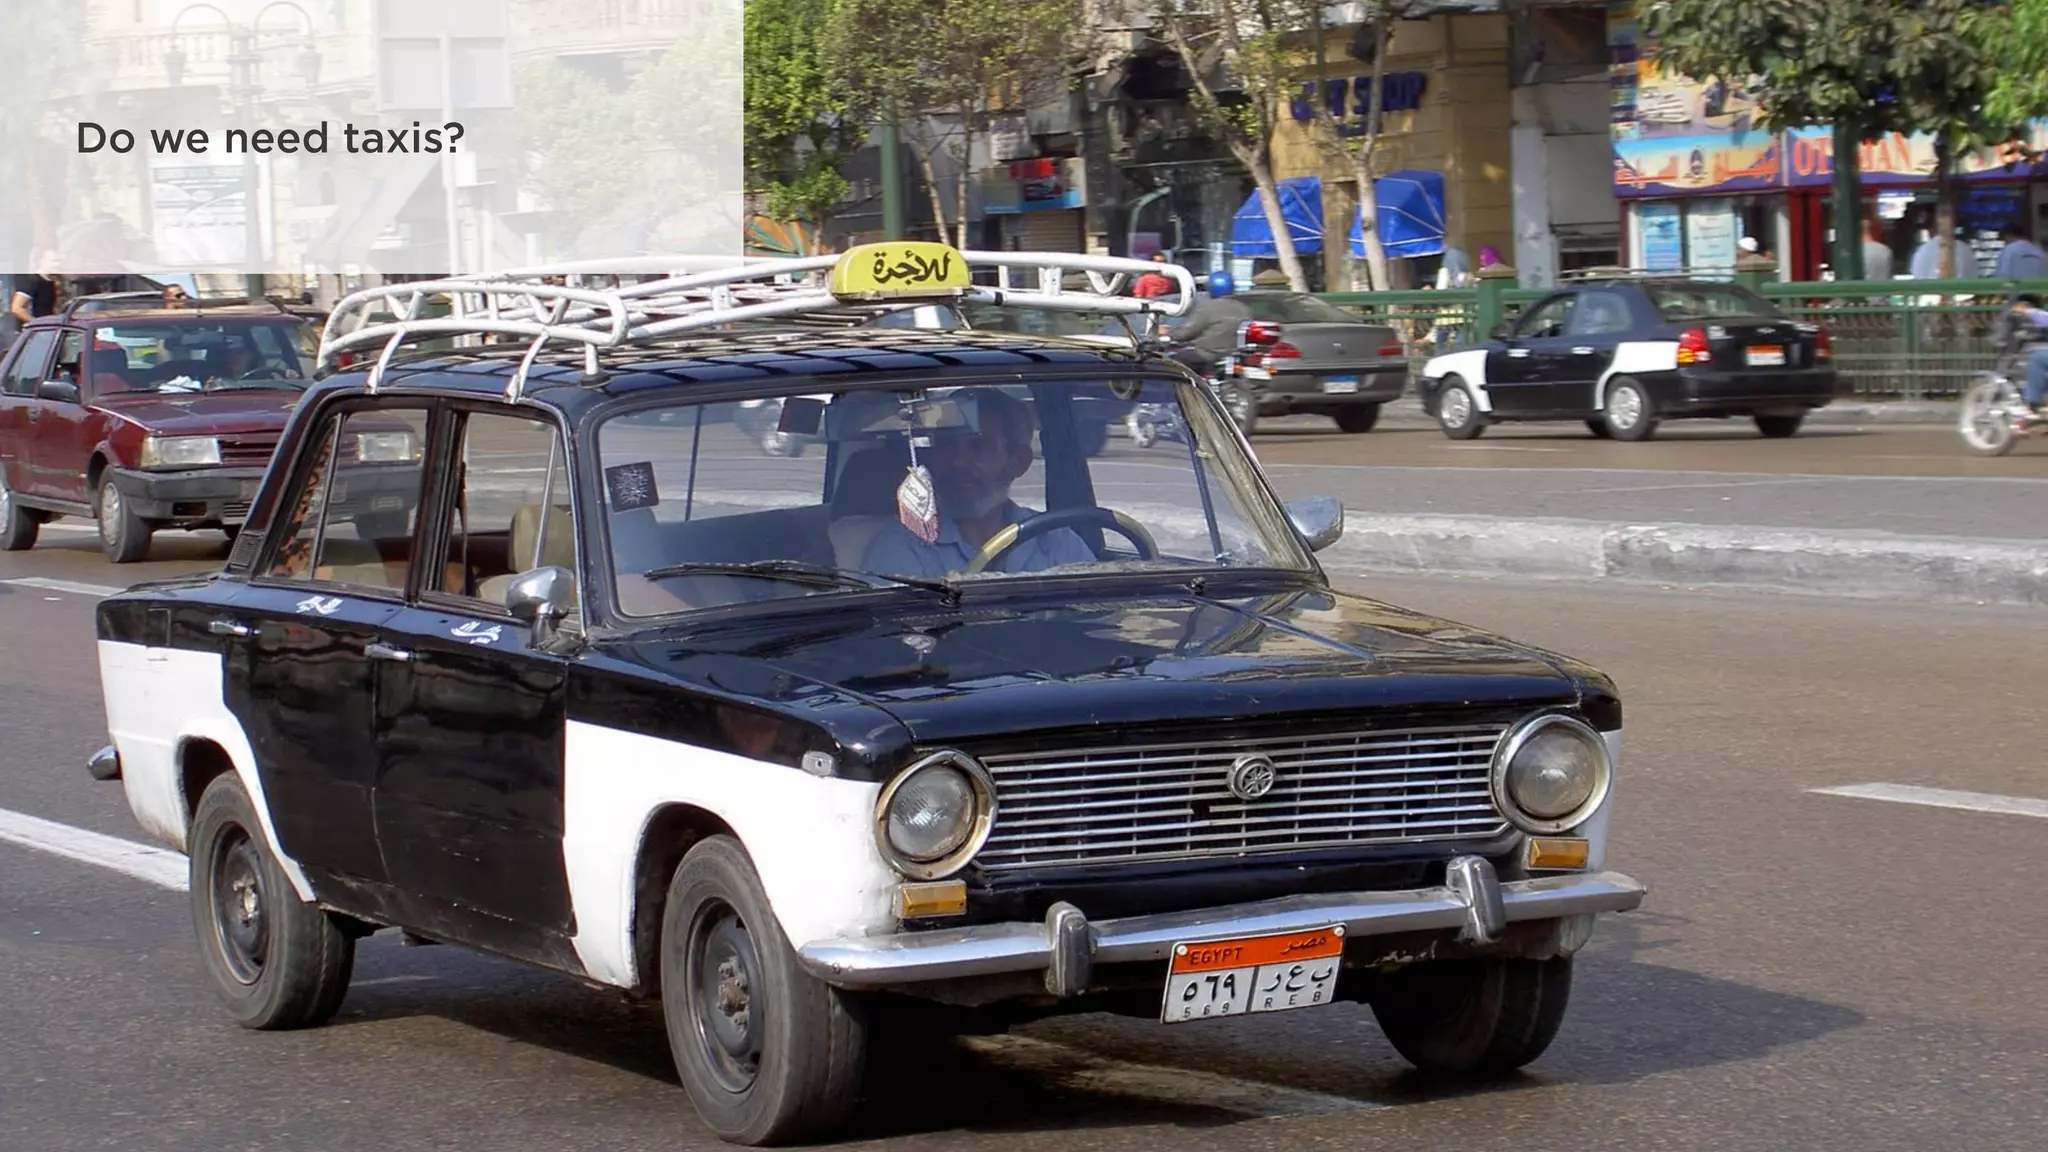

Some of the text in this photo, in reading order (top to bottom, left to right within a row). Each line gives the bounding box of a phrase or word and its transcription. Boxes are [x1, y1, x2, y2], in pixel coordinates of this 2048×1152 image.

[1792, 131, 1912, 177] OTMAN
[872, 249, 952, 286] للأجرة
[1280, 936, 1326, 955] مصر
[1189, 946, 1245, 965] EGYPT
[1264, 990, 1321, 1008] REB
[1183, 1001, 1230, 1018] 569
